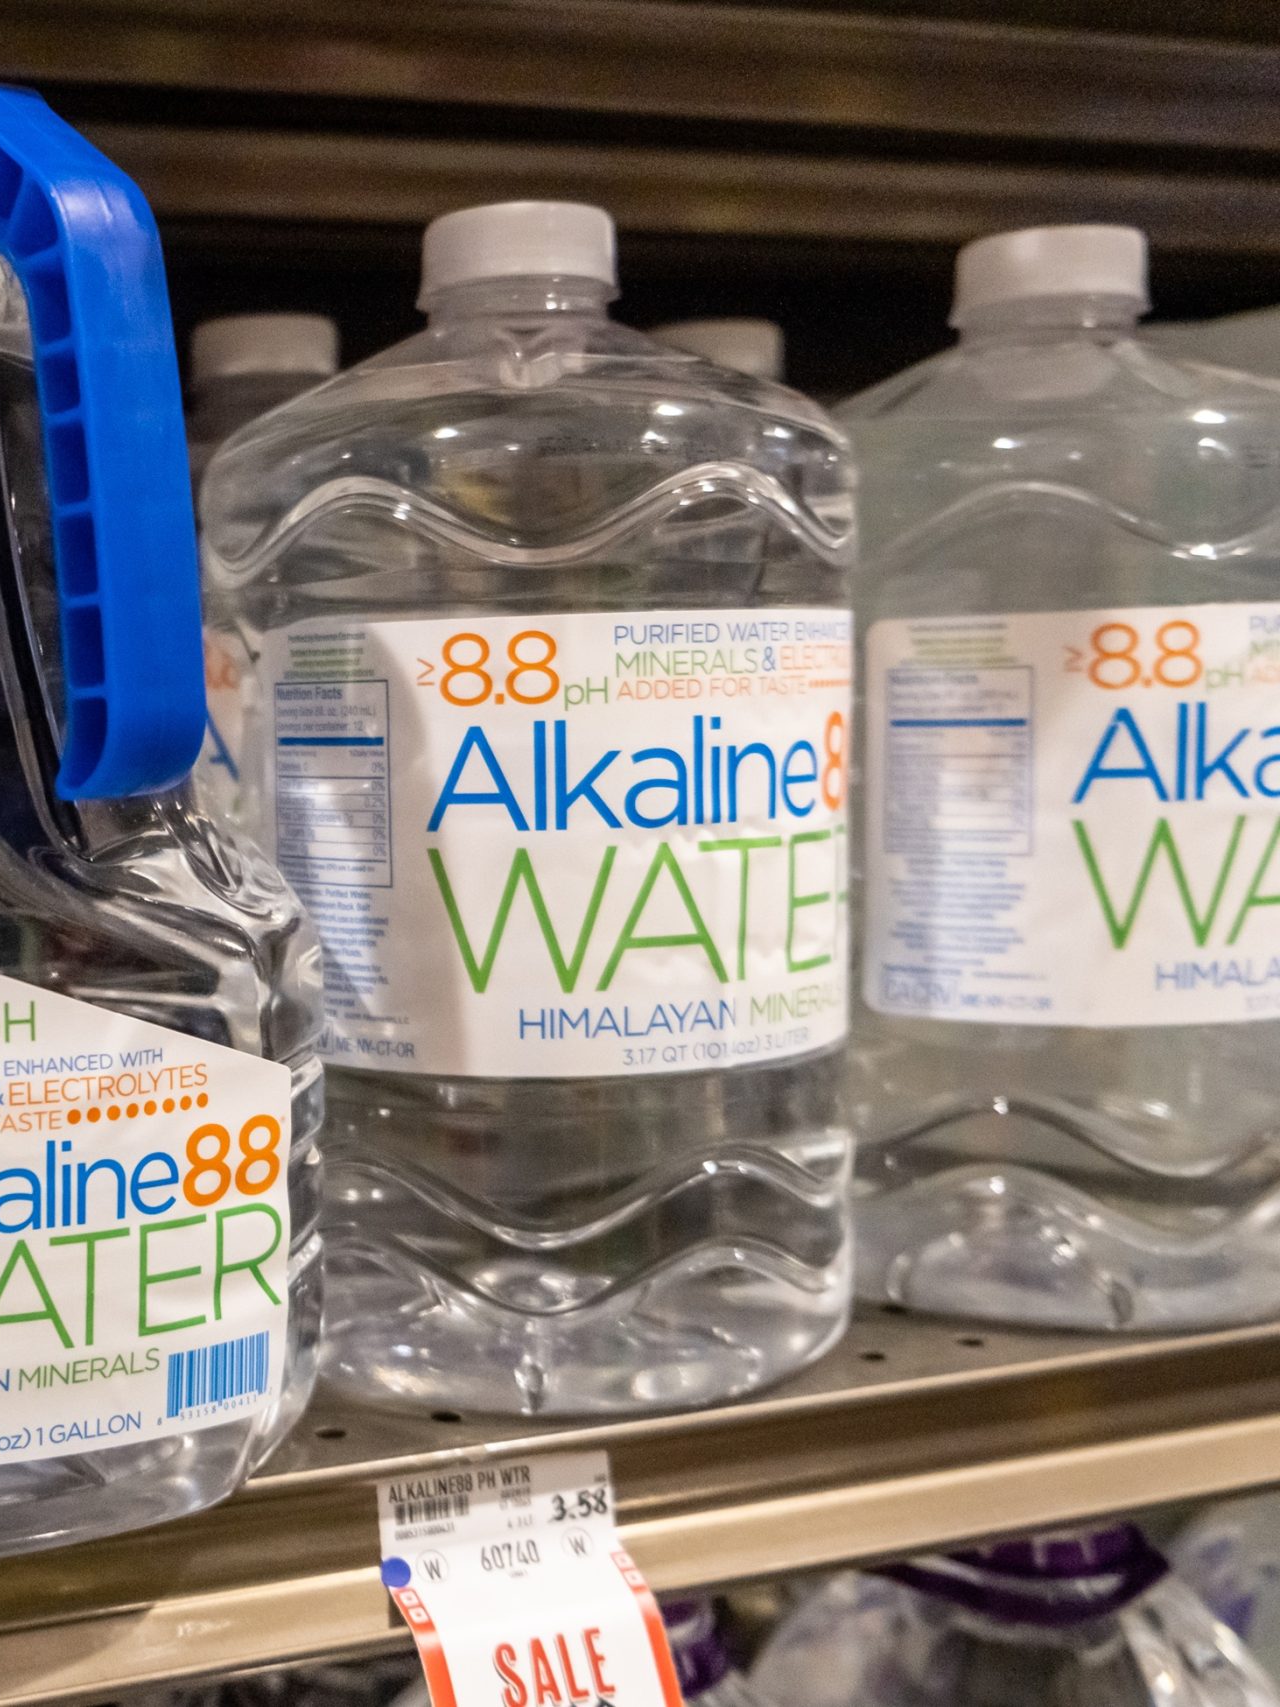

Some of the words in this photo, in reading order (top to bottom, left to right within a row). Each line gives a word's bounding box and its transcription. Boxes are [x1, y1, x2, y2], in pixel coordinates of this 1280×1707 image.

[614, 623, 720, 645] PURIFIED
[726, 621, 788, 641] WATER
[616, 648, 758, 677] MINERALS
[762, 646, 776, 671] &
[564, 676, 608, 711] pH
[616, 679, 702, 700] ADDED
[710, 677, 751, 697] FOR
[758, 674, 806, 696] TASTE
[519, 999, 736, 1039] HIMALAYAN
[4, 1053, 113, 1077] ENHANCED
[120, 1048, 163, 1068] WITH
[622, 1047, 656, 1066] 3.17
[662, 1044, 689, 1063] QT
[8, 1063, 208, 1107] ELECTROLYTES
[18, 1348, 160, 1391] MINERALS
[36, 1427, 43, 1446] 1
[49, 1411, 141, 1444] GALLON
[389, 1472, 473, 1503] ALKALINE88
[477, 1471, 496, 1490] PH
[499, 1464, 531, 1487] WTR
[552, 1487, 608, 1522] 3.58
[481, 1539, 540, 1571] 60740
[568, 1536, 587, 1556] W
[423, 1558, 442, 1580] W
[493, 1628, 615, 1707] SALE
